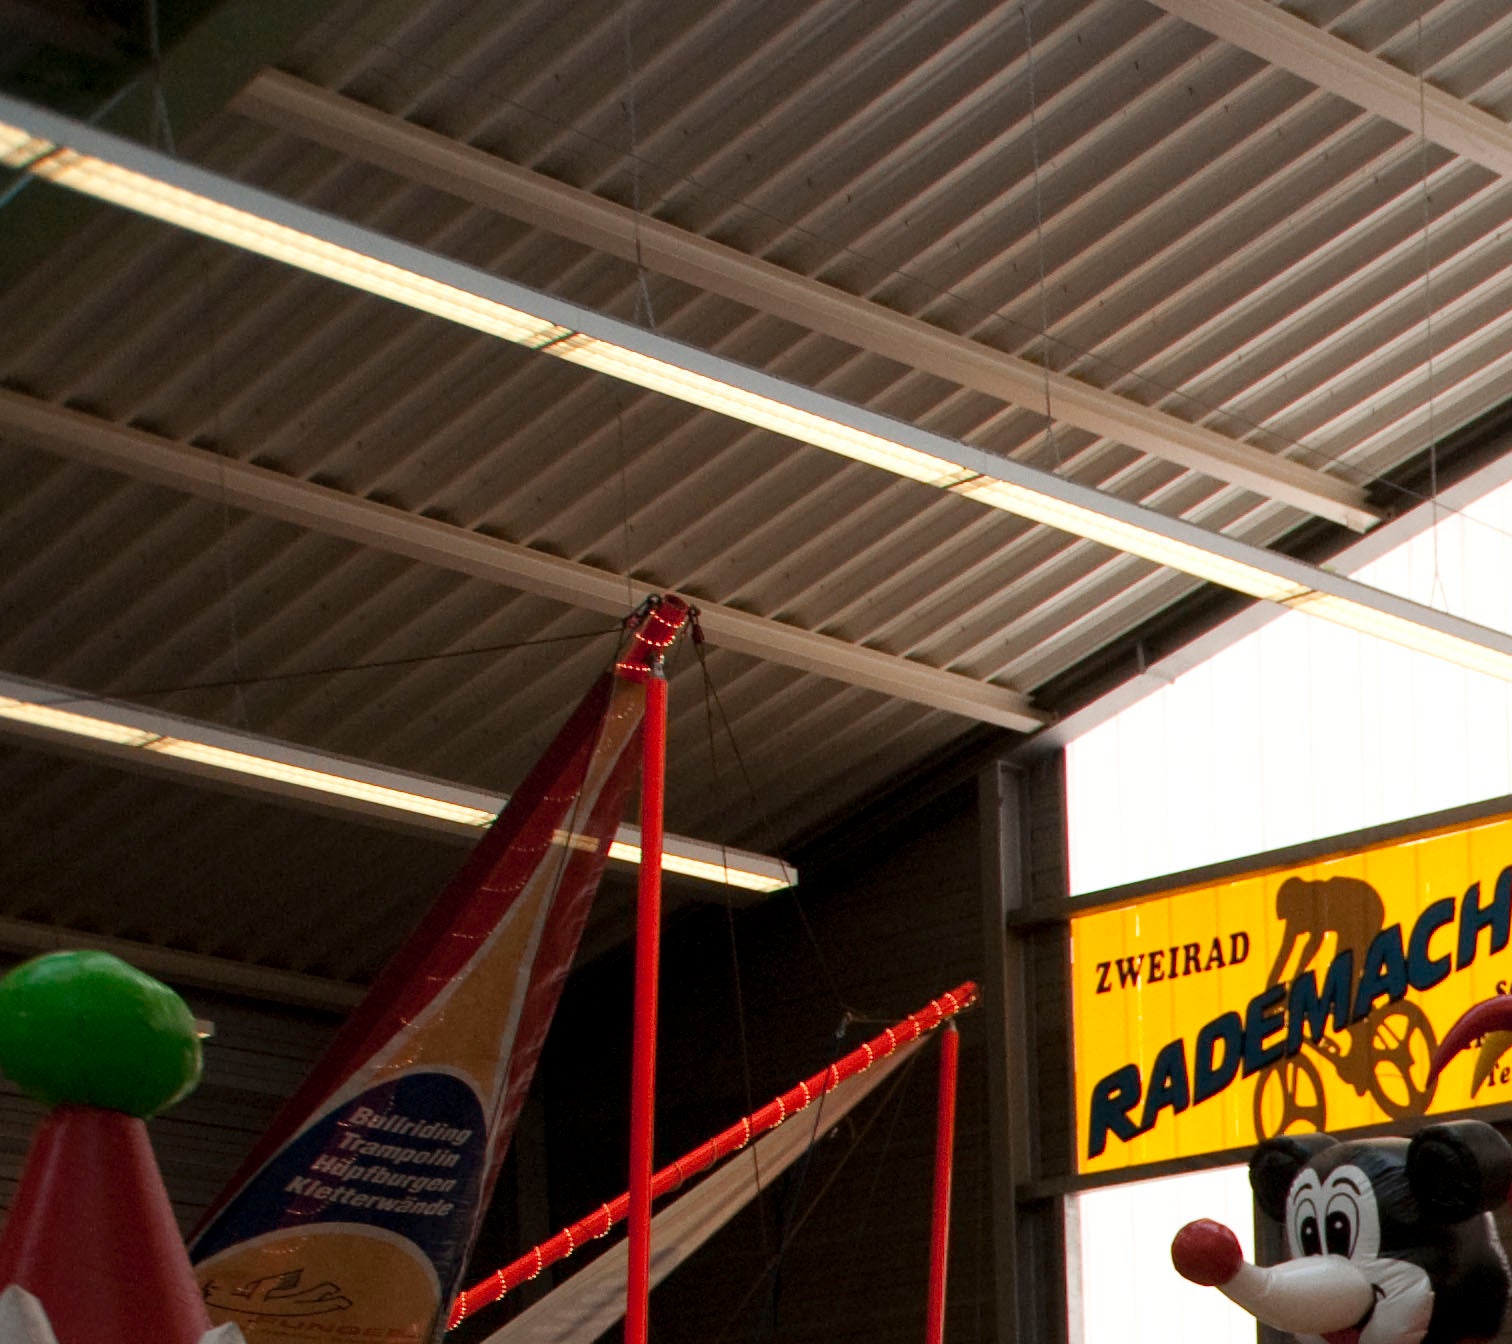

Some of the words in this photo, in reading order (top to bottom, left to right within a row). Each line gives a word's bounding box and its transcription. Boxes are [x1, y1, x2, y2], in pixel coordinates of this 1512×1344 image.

[1096, 932, 1251, 995] ZWEIRAD
[349, 1105, 473, 1146] Bullriding
[338, 1131, 462, 1168] Trampolin
[283, 1174, 455, 1217] Kletterwände
